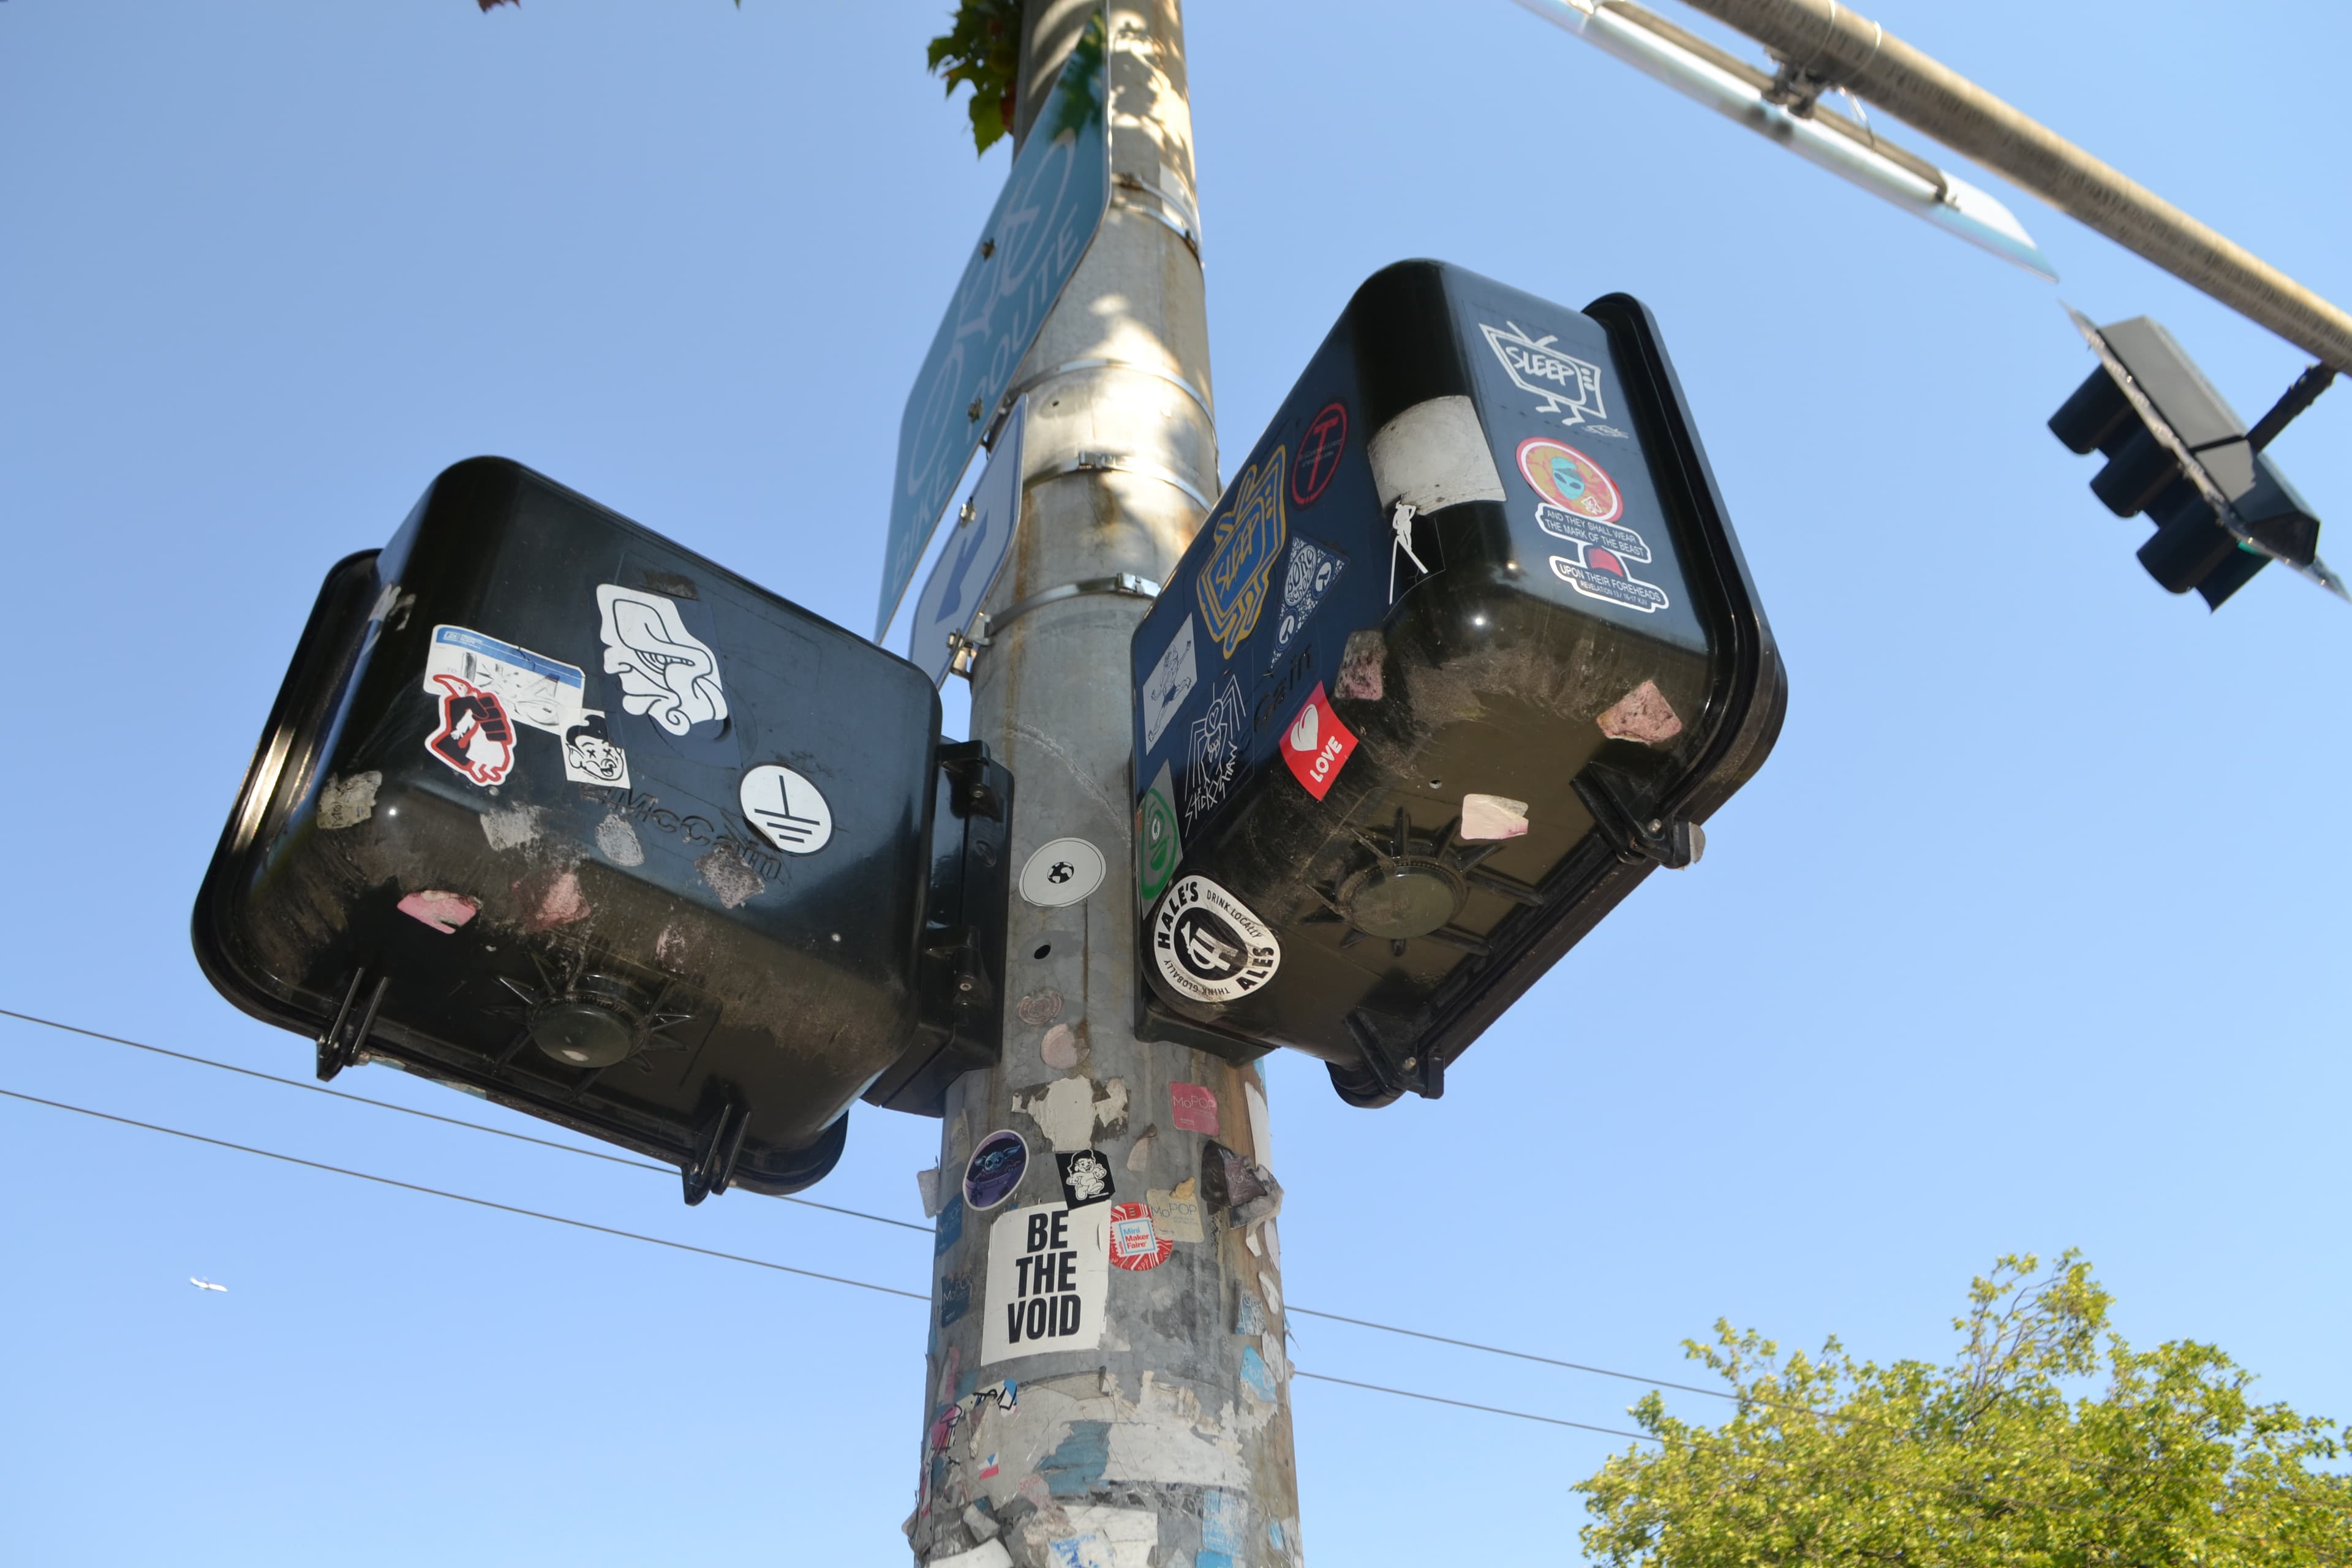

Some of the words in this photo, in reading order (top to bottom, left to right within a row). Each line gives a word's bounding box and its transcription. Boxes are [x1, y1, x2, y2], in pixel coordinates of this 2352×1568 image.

[1506, 346, 1575, 386] SLEEP
[892, 438, 952, 594] BIKE
[1547, 510, 1563, 521] AND
[1565, 515, 1585, 527] THEY
[1587, 522, 1612, 537] SHALL
[1613, 530, 1636, 544] WEAR
[1215, 511, 1260, 601] SLEEP
[1545, 519, 1561, 532] THE
[1564, 525, 1588, 540] MARK
[1588, 532, 1599, 543] OF
[1601, 536, 1618, 548] THE
[1618, 542, 1644, 557] BEAST
[1559, 564, 1584, 579] UPON
[1585, 571, 1611, 587] THEIR
[1611, 579, 1662, 602] FOREHEADS
[1580, 580, 1612, 596] REVELATION
[1309, 736, 1343, 783] LOVE
[1158, 881, 1199, 949] HALE'S
[1207, 889, 1231, 912] DRINK
[1231, 908, 1262, 938] LOCALLY
[1164, 960, 1198, 992] GLOBALLY
[1235, 947, 1274, 991] ALES
[1202, 987, 1230, 996] THINK
[1173, 1095, 1216, 1110] MoPOP
[1151, 1203, 1197, 1218] MoPOP
[1027, 1210, 1069, 1253] BE
[1125, 1234, 1149, 1242] Maker
[1016, 1251, 1077, 1298] THE
[1008, 1294, 1081, 1344] VOID
